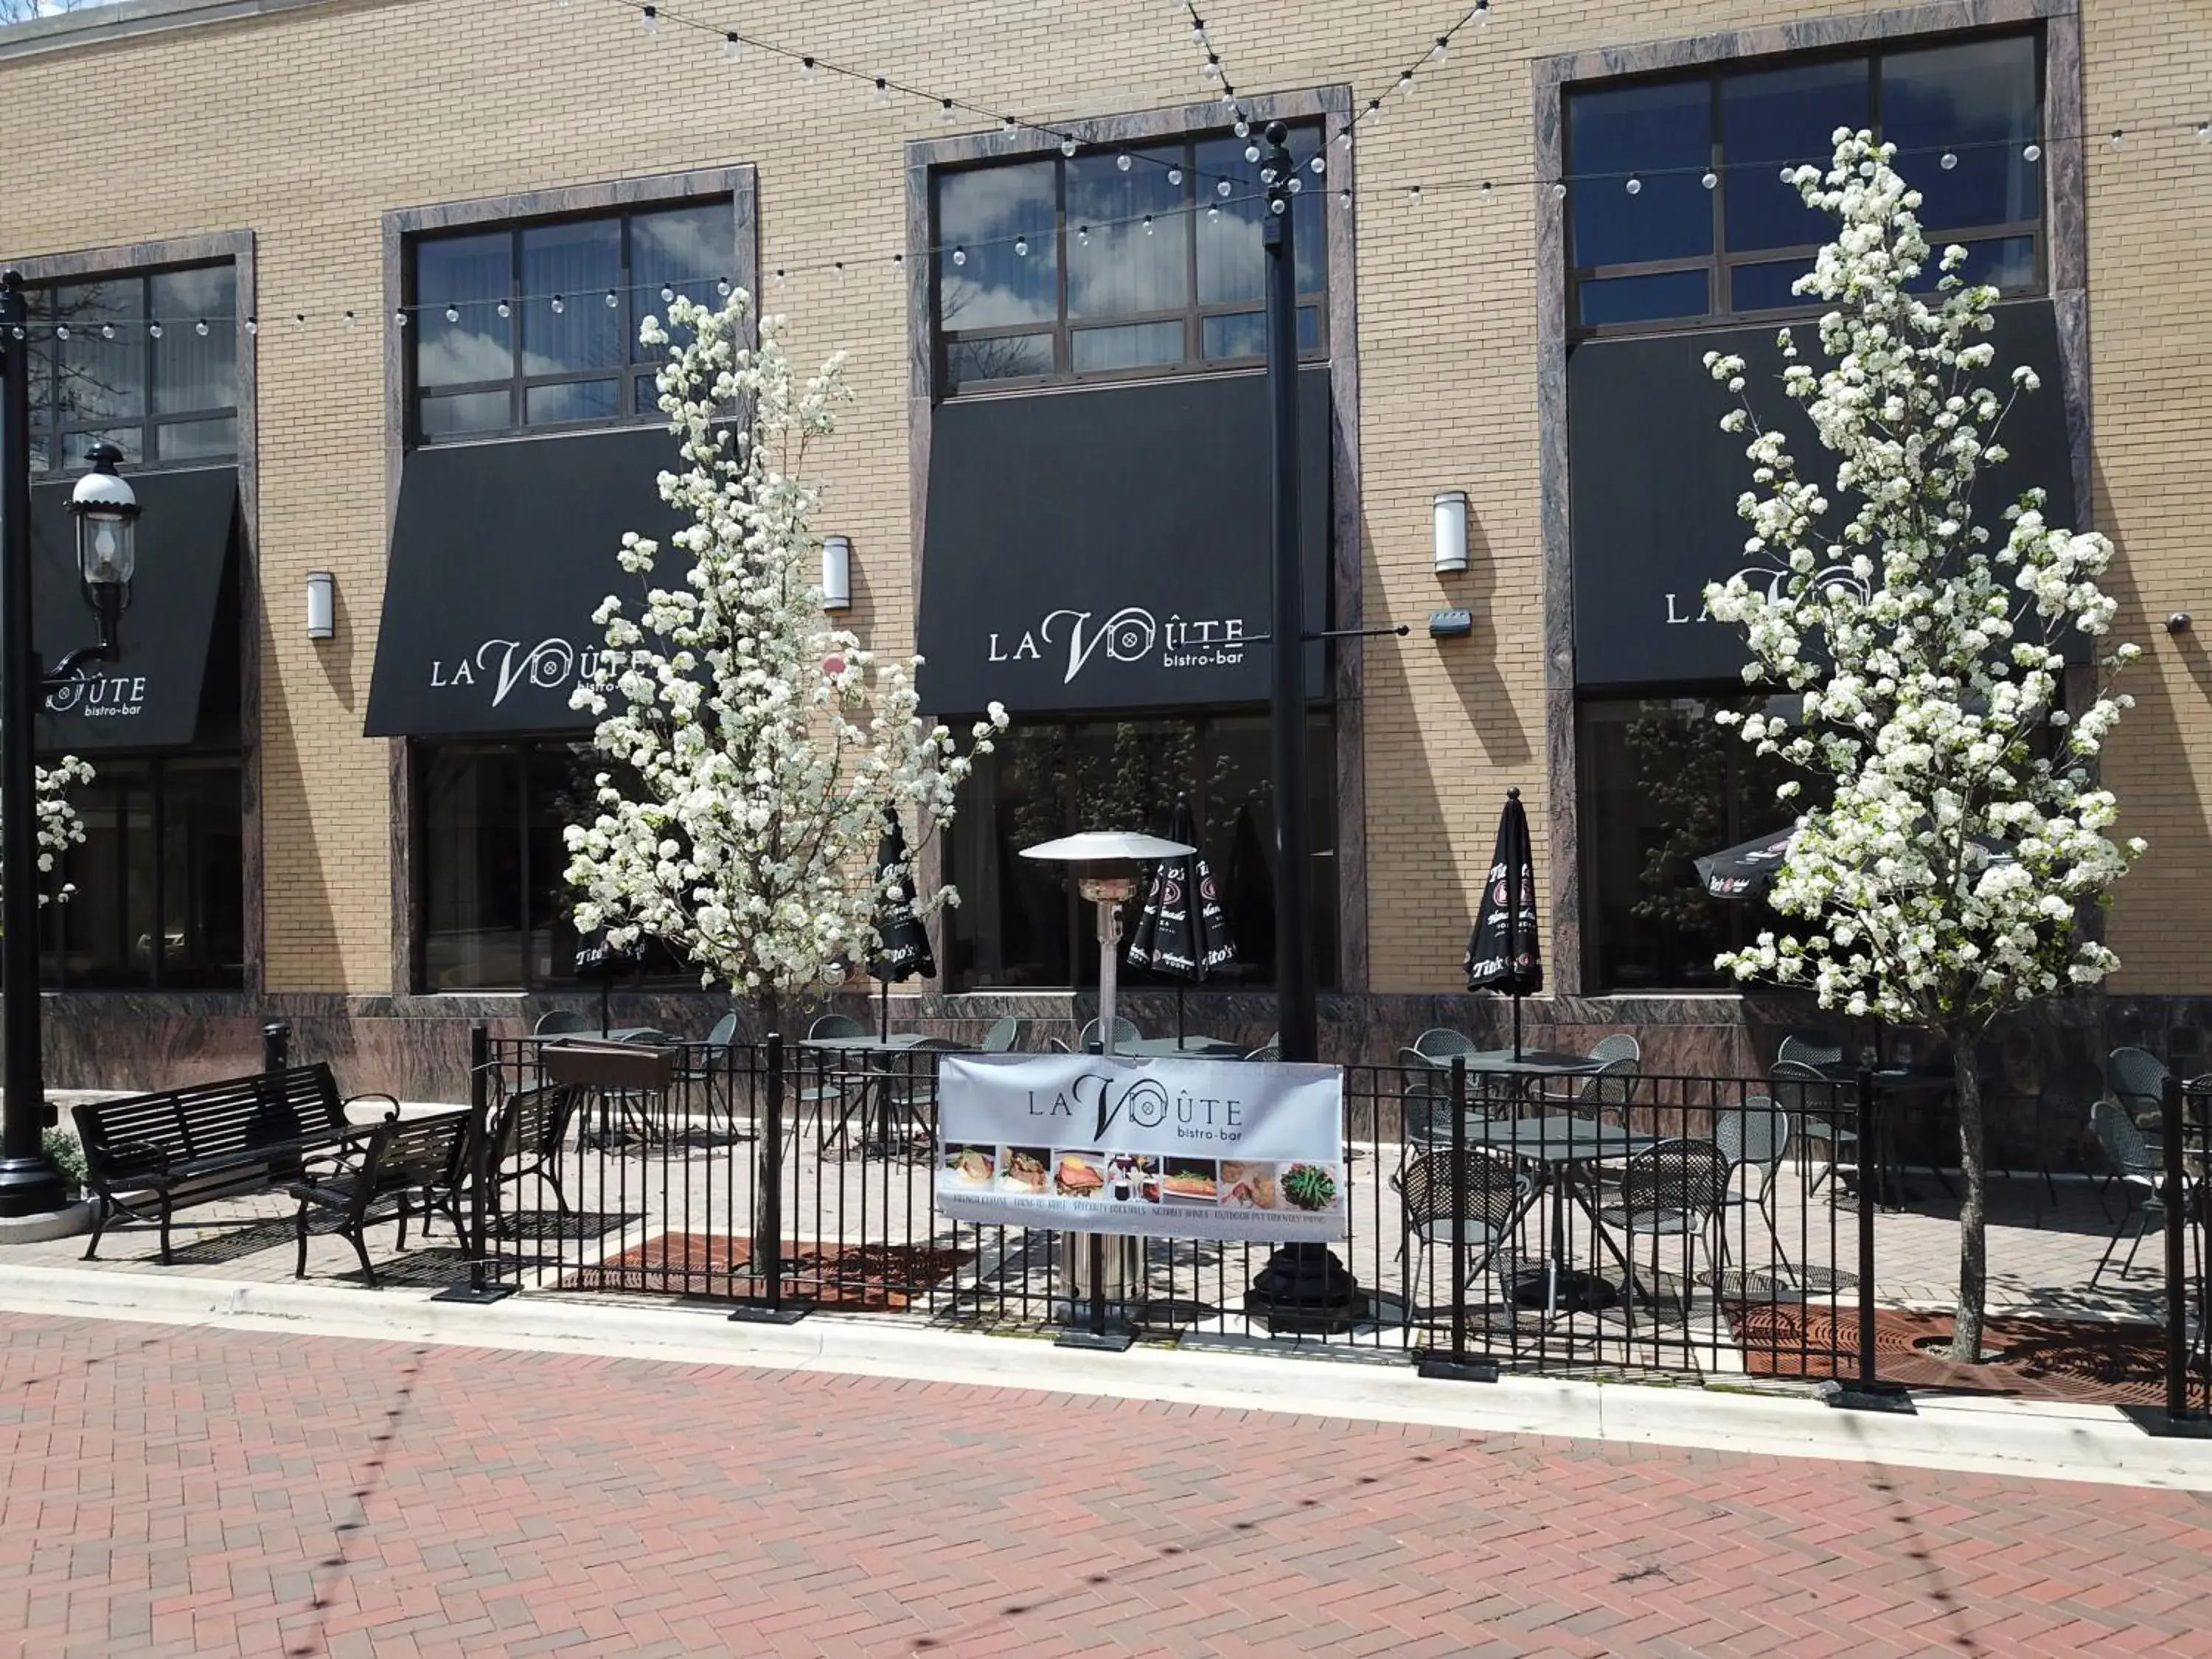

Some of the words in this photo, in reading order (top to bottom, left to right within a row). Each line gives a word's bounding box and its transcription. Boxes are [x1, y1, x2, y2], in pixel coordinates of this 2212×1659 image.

[989, 631, 1041, 661] LA
[430, 658, 476, 687] LA
[1028, 1090, 1074, 1116] LA
[1071, 1073, 1243, 1143] VOÛTE
[1177, 1126, 1243, 1141] bistro-bar
